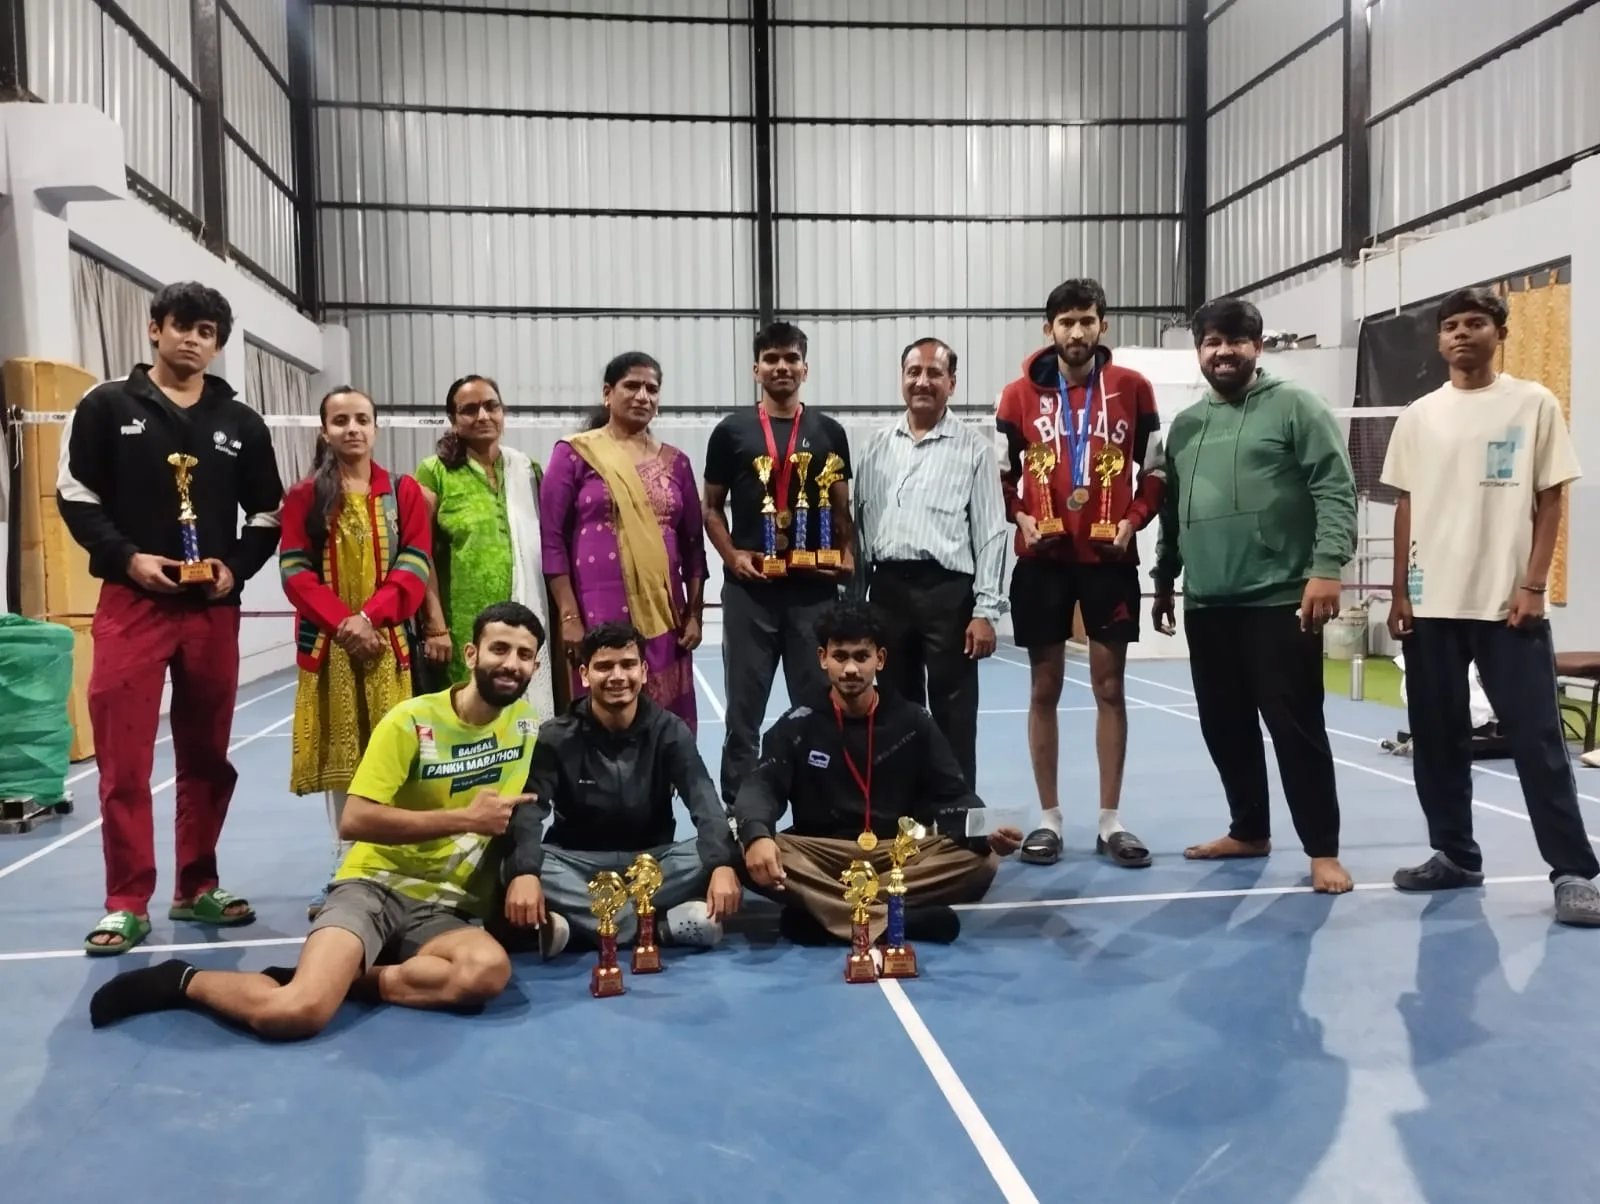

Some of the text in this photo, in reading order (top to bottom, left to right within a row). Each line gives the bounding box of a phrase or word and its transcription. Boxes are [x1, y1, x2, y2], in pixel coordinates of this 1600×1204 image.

[457, 741, 494, 757] BANSAL
[426, 749, 520, 776] PANKH MARATHON
